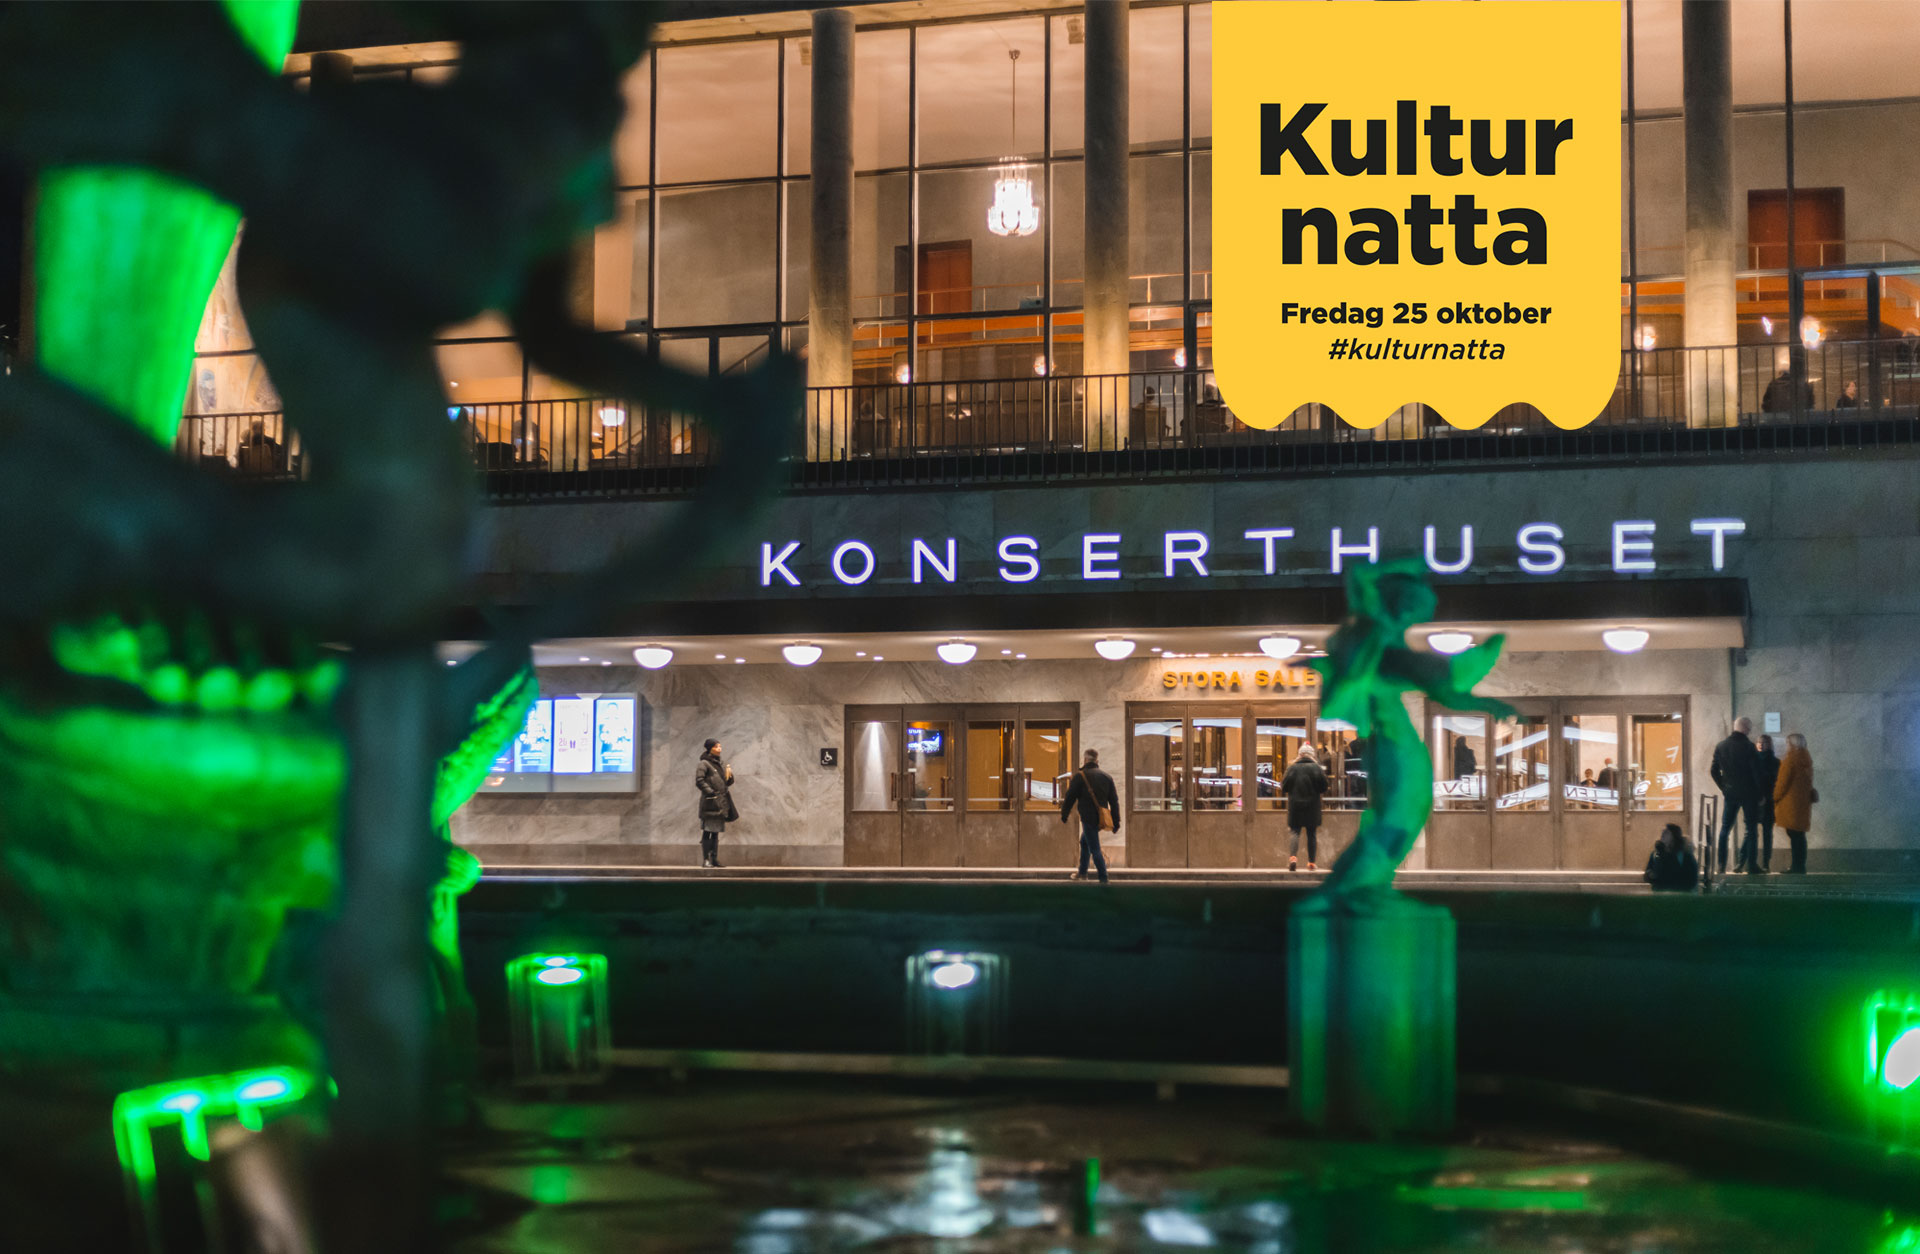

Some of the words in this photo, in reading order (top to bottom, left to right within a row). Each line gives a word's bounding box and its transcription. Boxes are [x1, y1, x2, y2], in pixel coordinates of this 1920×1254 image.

[762, 521, 1747, 587] KONSERTHUSET
[1163, 671, 1243, 688] STORA
[1255, 669, 1317, 687] SALE
